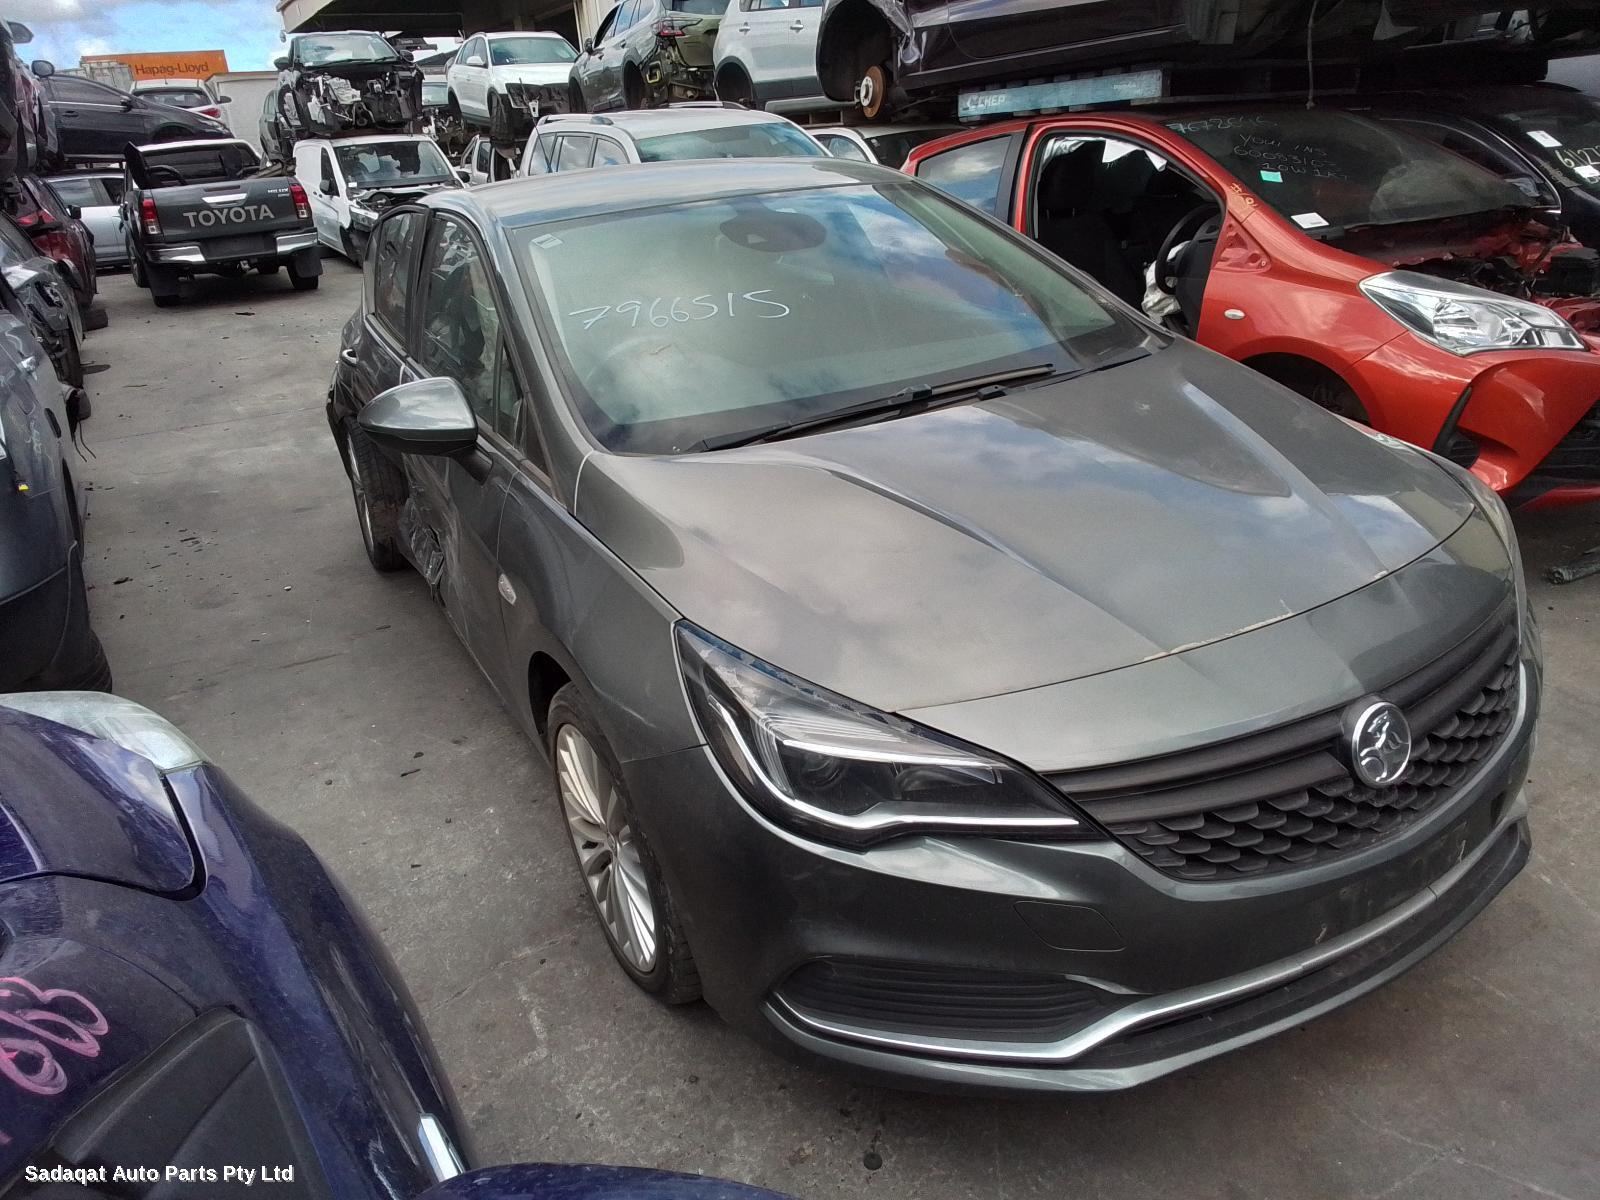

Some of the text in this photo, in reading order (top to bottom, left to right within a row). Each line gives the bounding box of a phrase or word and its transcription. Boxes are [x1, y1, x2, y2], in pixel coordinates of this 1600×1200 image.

[135, 62, 209, 76] Hapag-Lloyd
[183, 204, 275, 228] TOYOTA
[568, 289, 791, 330] 7966515
